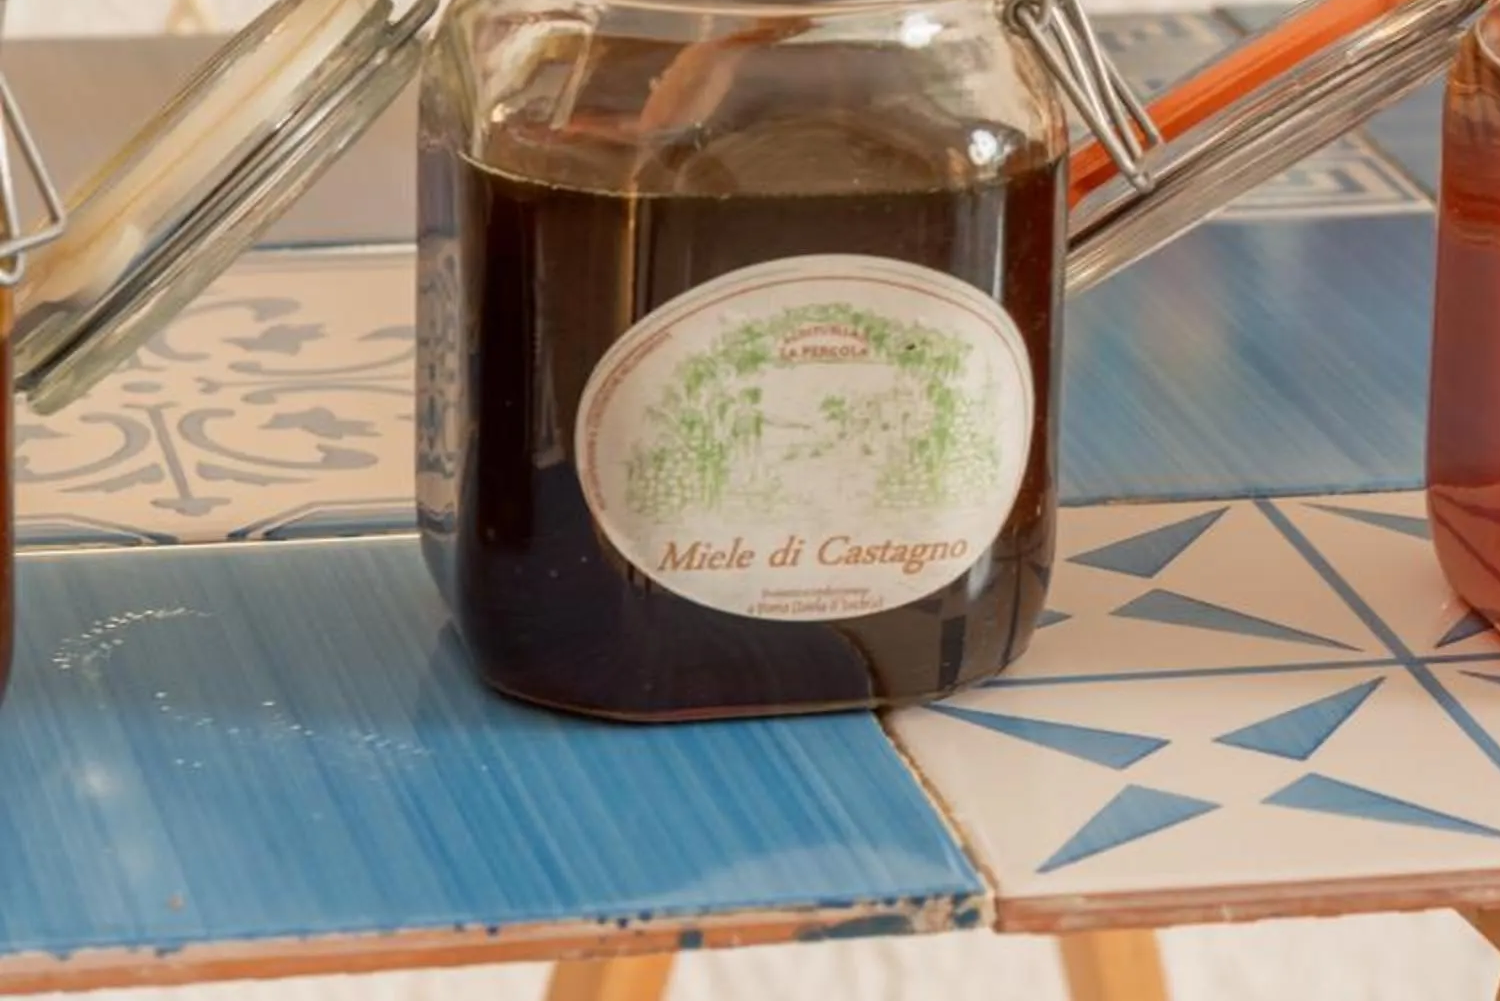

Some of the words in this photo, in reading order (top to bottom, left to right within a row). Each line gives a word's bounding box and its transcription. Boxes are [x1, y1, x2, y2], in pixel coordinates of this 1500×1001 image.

[657, 537, 755, 571] Miele
[768, 535, 806, 568] di
[818, 535, 968, 575] Castagno
